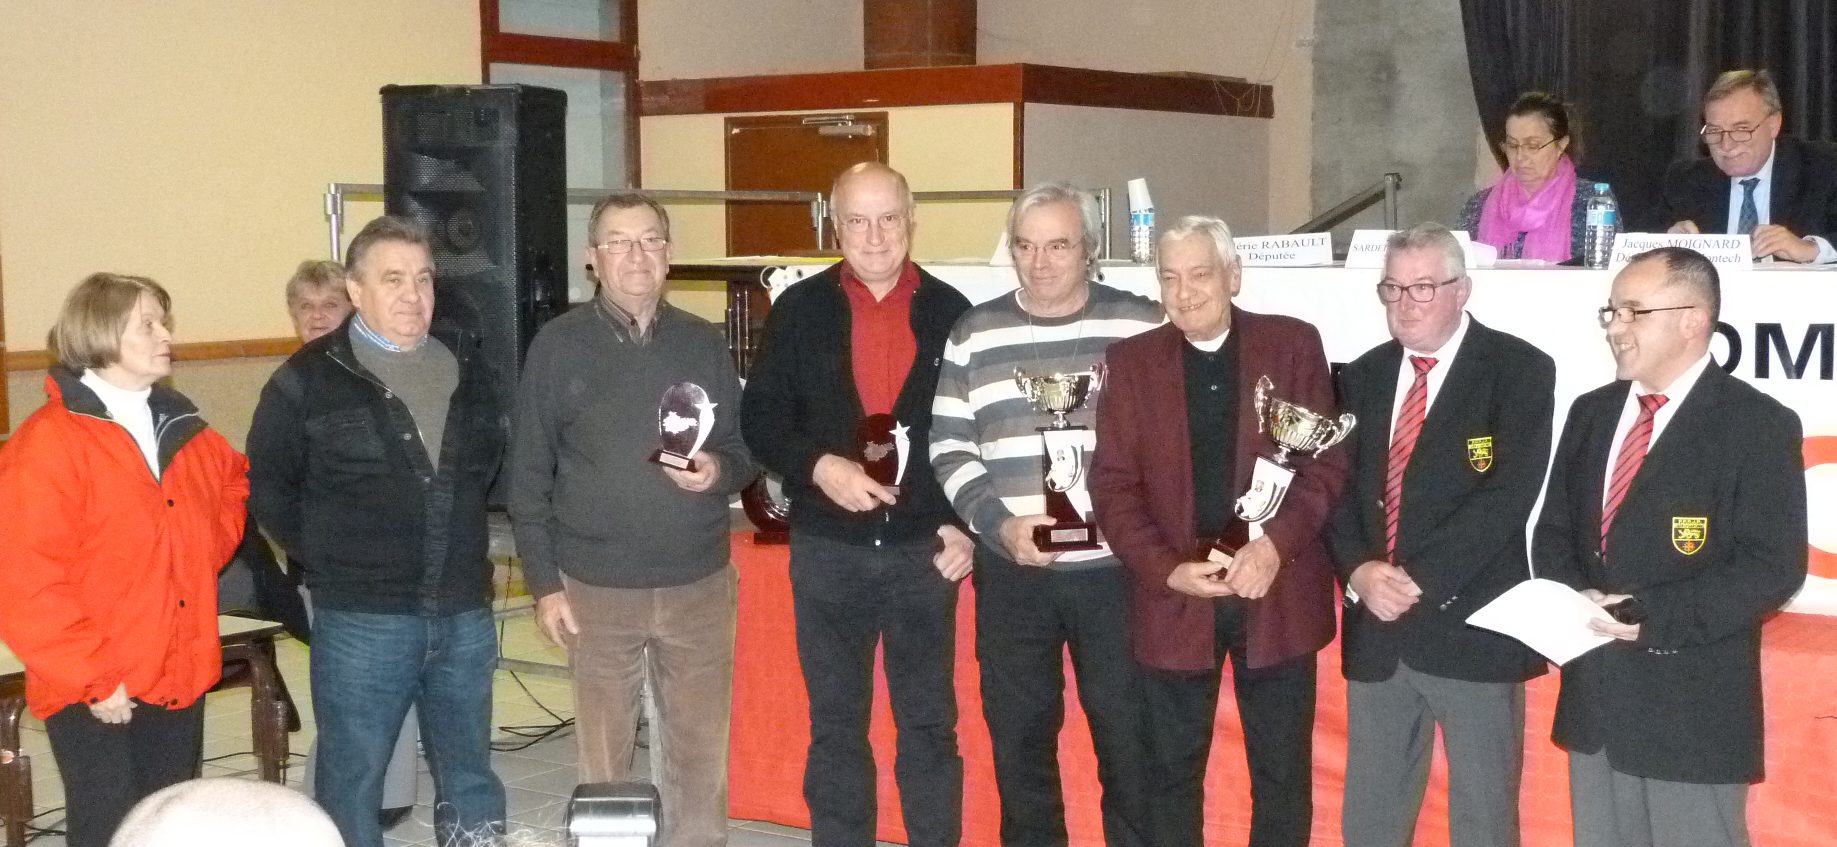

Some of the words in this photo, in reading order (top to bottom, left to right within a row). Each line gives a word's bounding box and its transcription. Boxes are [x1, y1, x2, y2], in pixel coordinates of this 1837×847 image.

[1262, 237, 1326, 249] RABAULT
[1622, 238, 1662, 249] Jacques
[1667, 239, 1740, 249] MOIGNARD
[1249, 252, 1296, 261] Députée
[1703, 253, 1741, 263] ontech
